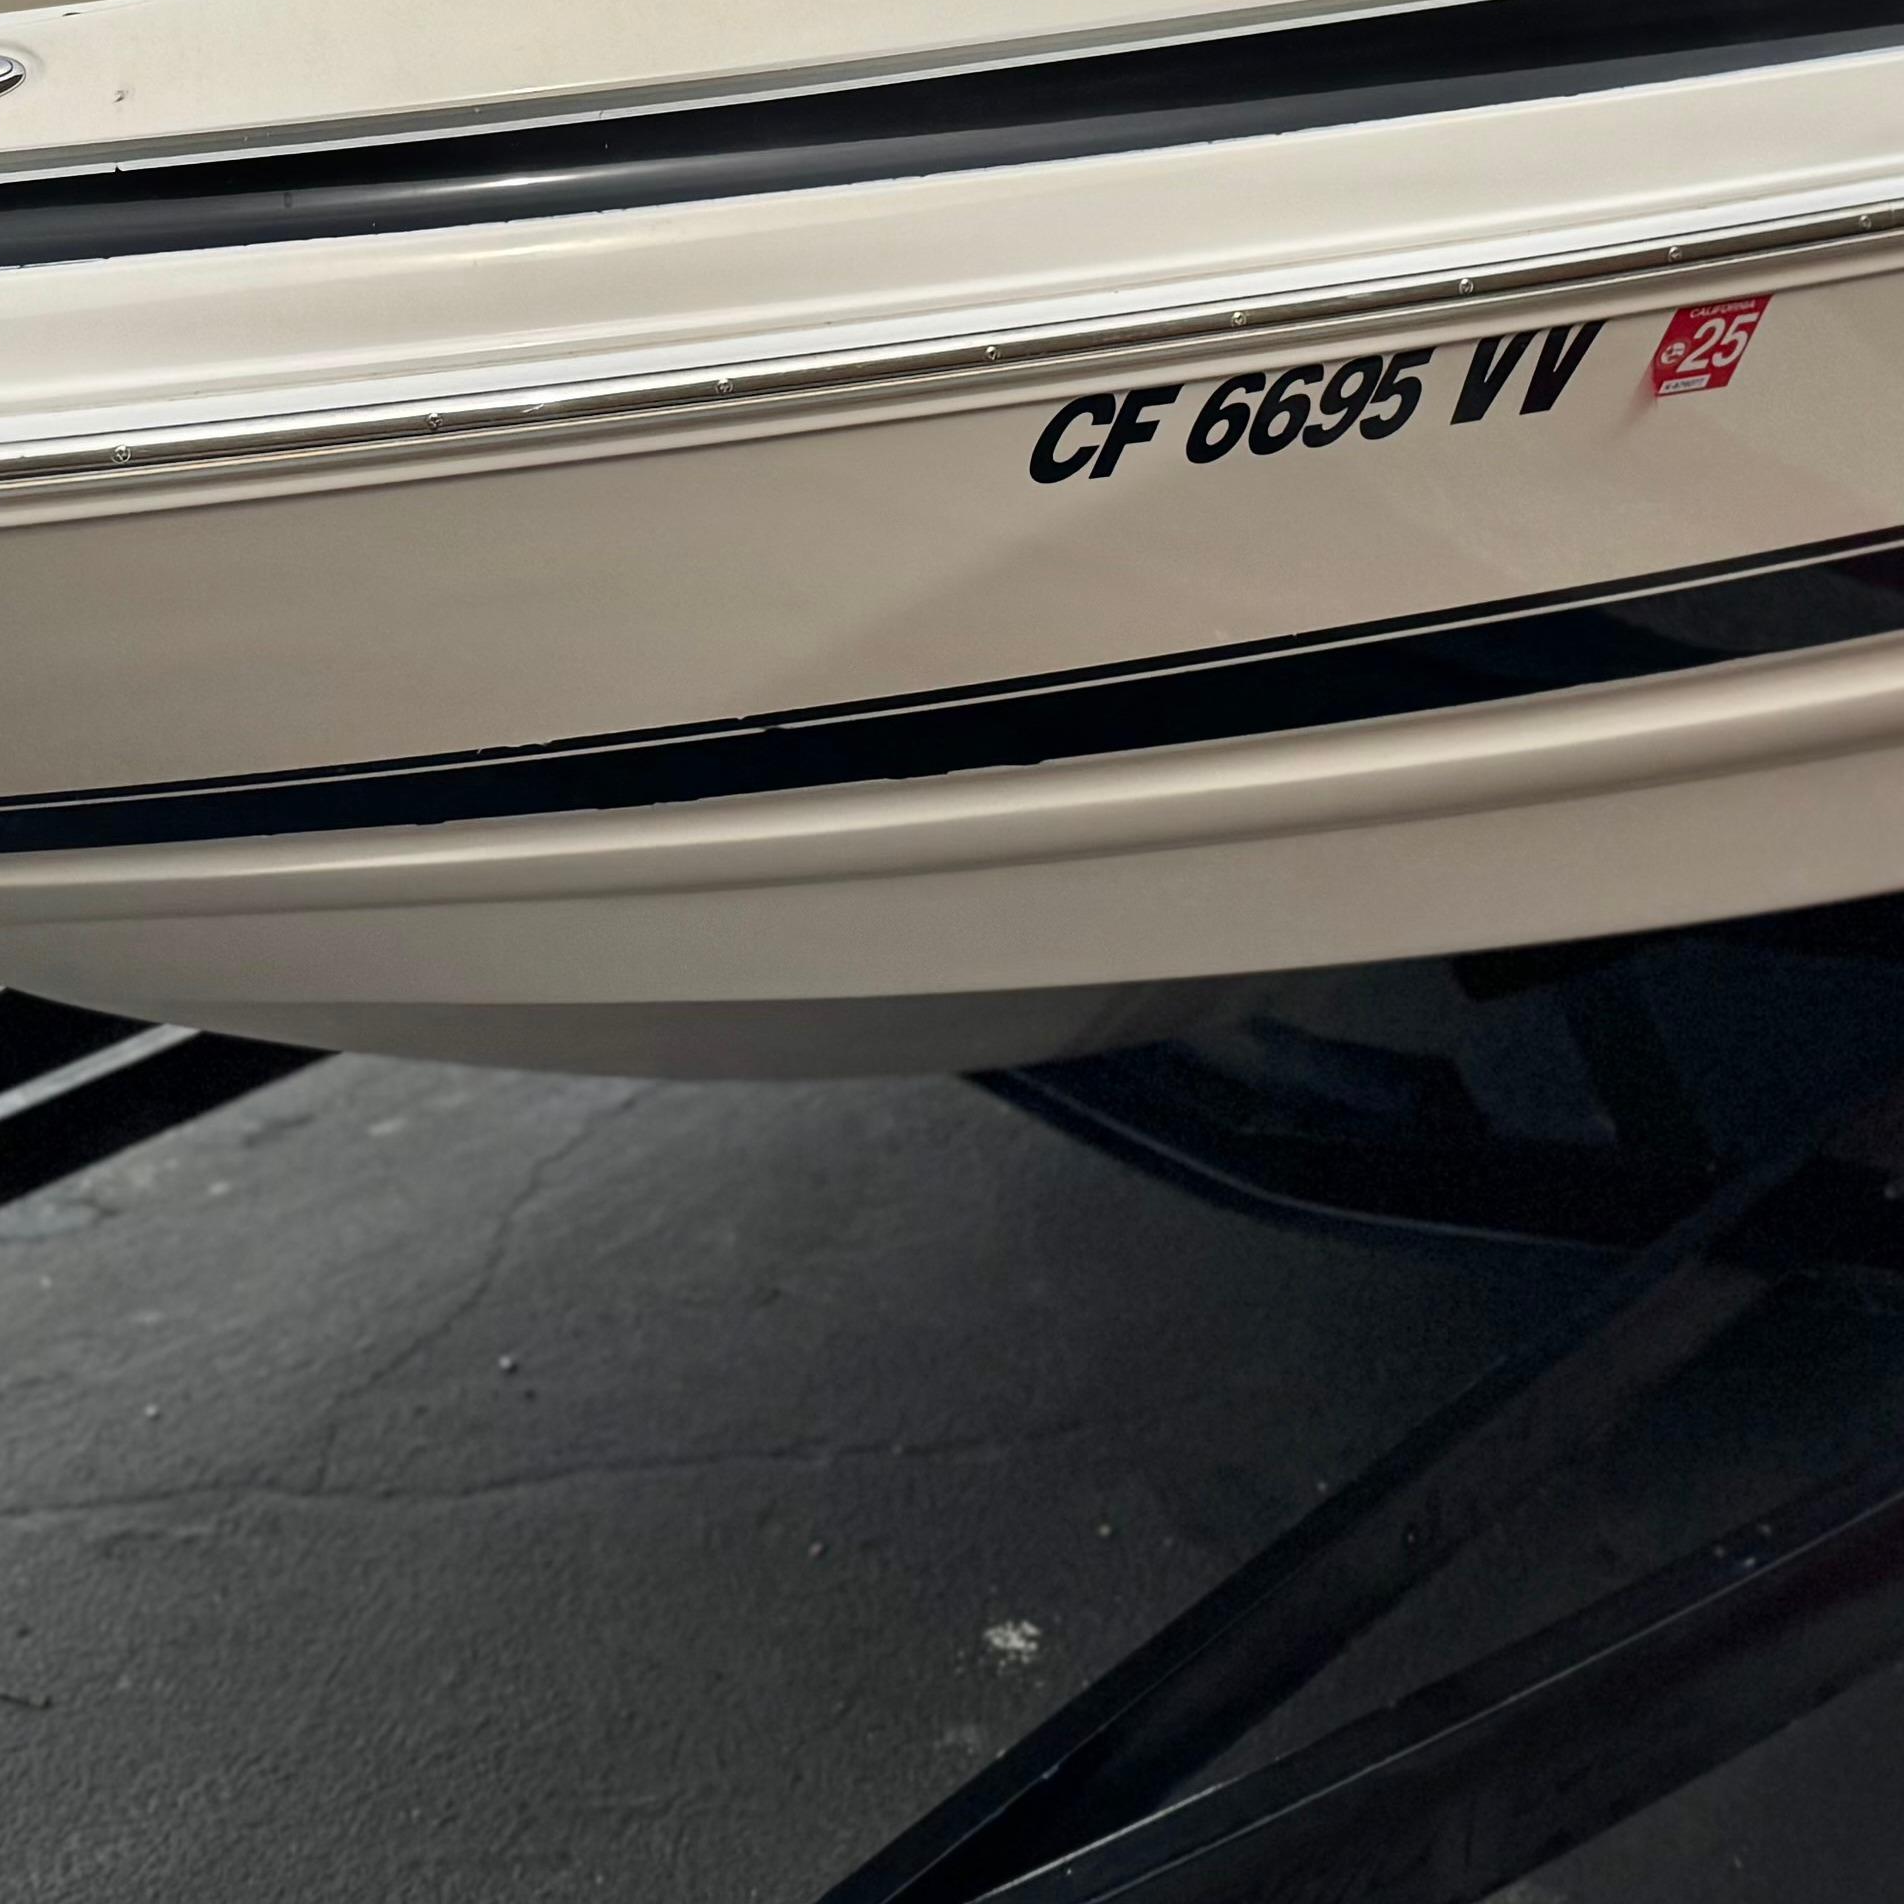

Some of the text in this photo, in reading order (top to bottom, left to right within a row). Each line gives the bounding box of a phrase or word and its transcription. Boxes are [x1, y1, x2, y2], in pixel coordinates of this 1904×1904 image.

[1676, 312, 1760, 373] 25
[1029, 319, 1609, 484] CF 6695 VV
